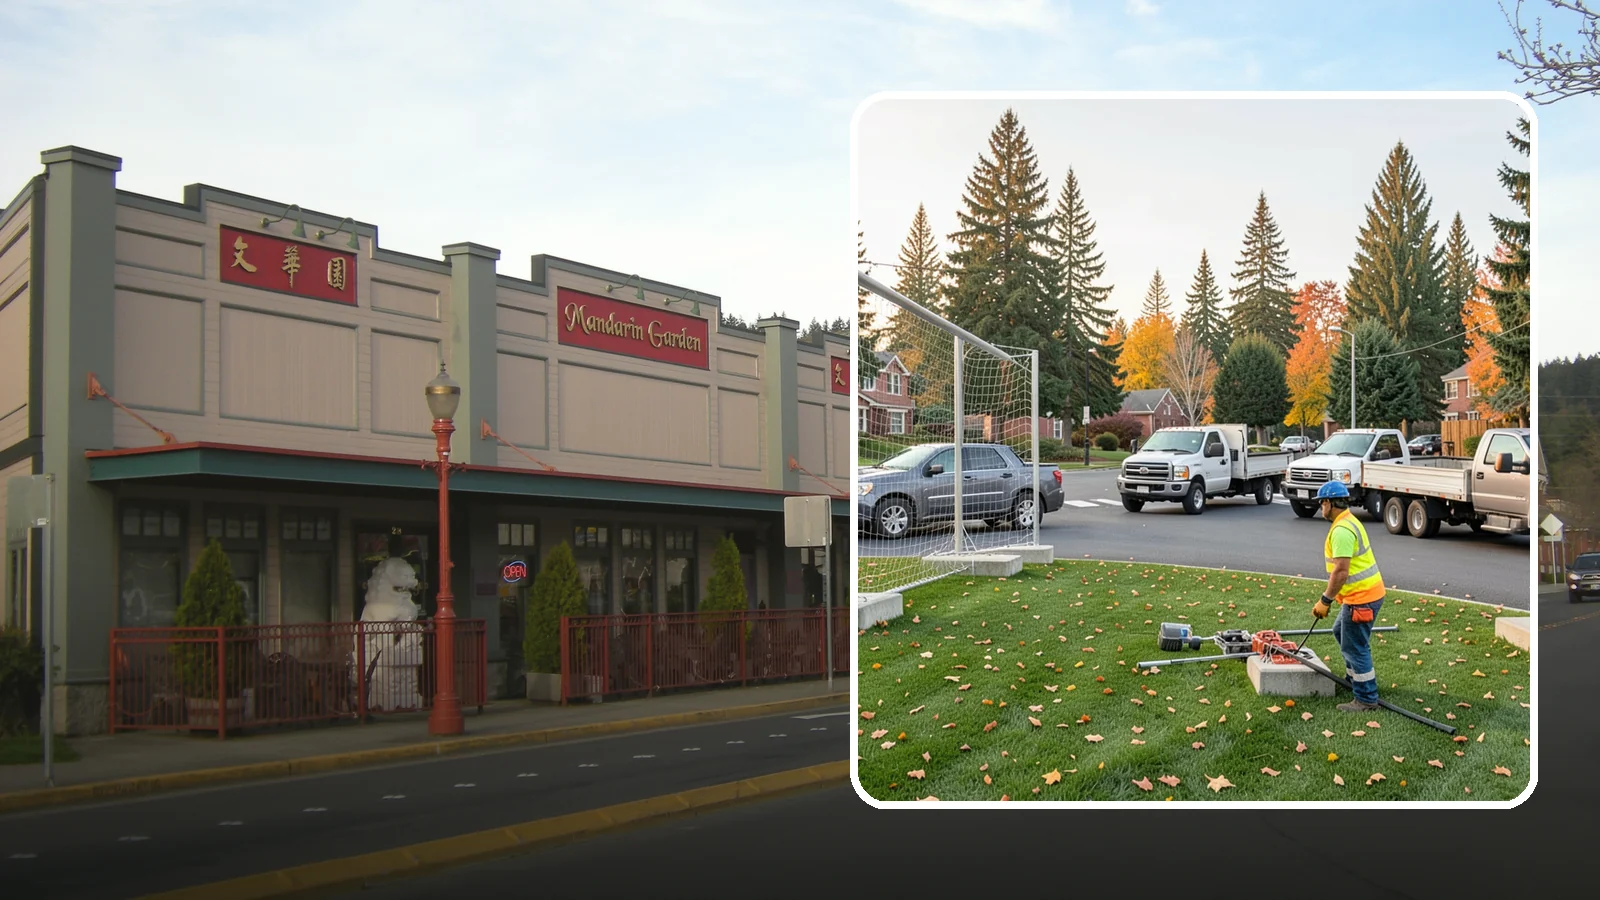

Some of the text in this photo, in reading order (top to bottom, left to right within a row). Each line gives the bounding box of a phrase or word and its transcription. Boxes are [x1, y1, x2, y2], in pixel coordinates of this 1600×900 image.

[230, 235, 346, 290] 文華園
[564, 302, 701, 352] Mandarin Garden
[835, 363, 847, 386] 文
[503, 565, 527, 578] OPEN
